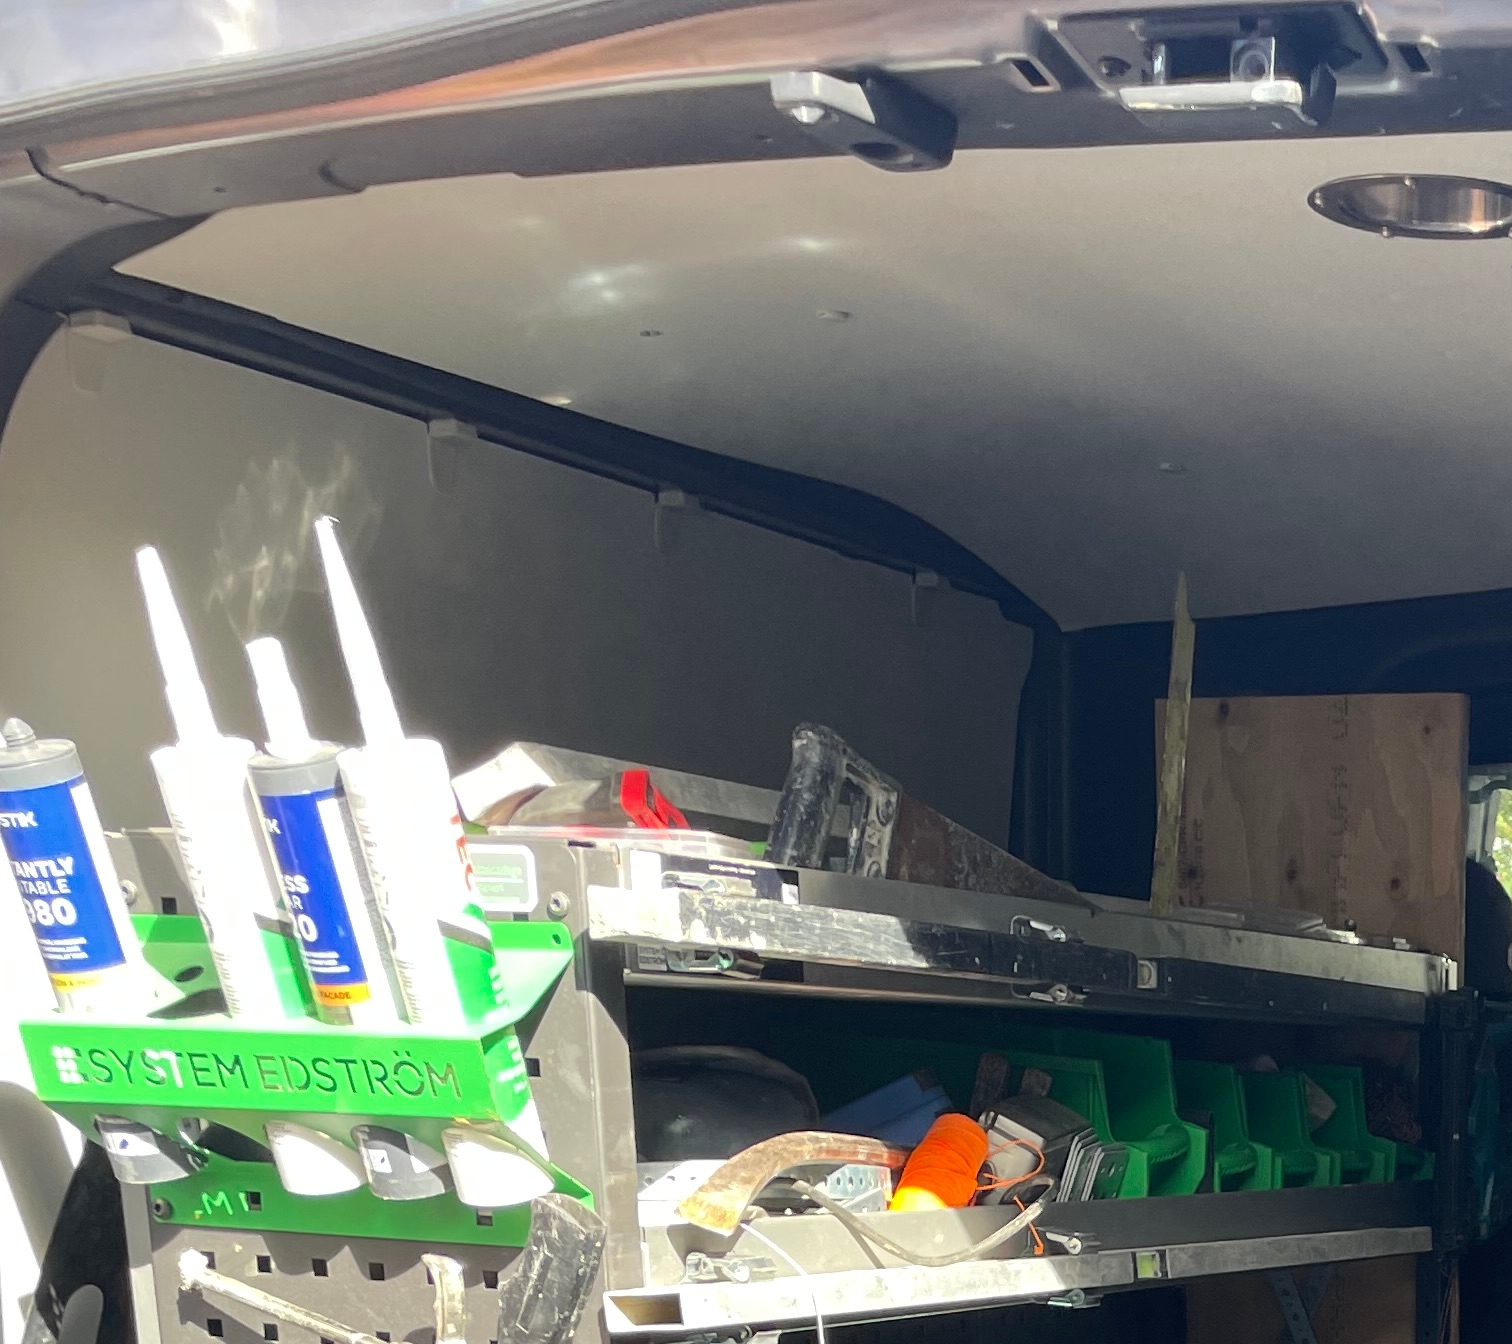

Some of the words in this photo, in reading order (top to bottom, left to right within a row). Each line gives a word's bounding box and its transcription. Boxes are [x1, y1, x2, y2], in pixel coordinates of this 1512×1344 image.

[11, 856, 73, 878] ANTLY
[20, 879, 71, 894] TABLE
[87, 1048, 250, 1092] SYSTEM
[255, 1050, 463, 1099] EDSTRÖM
